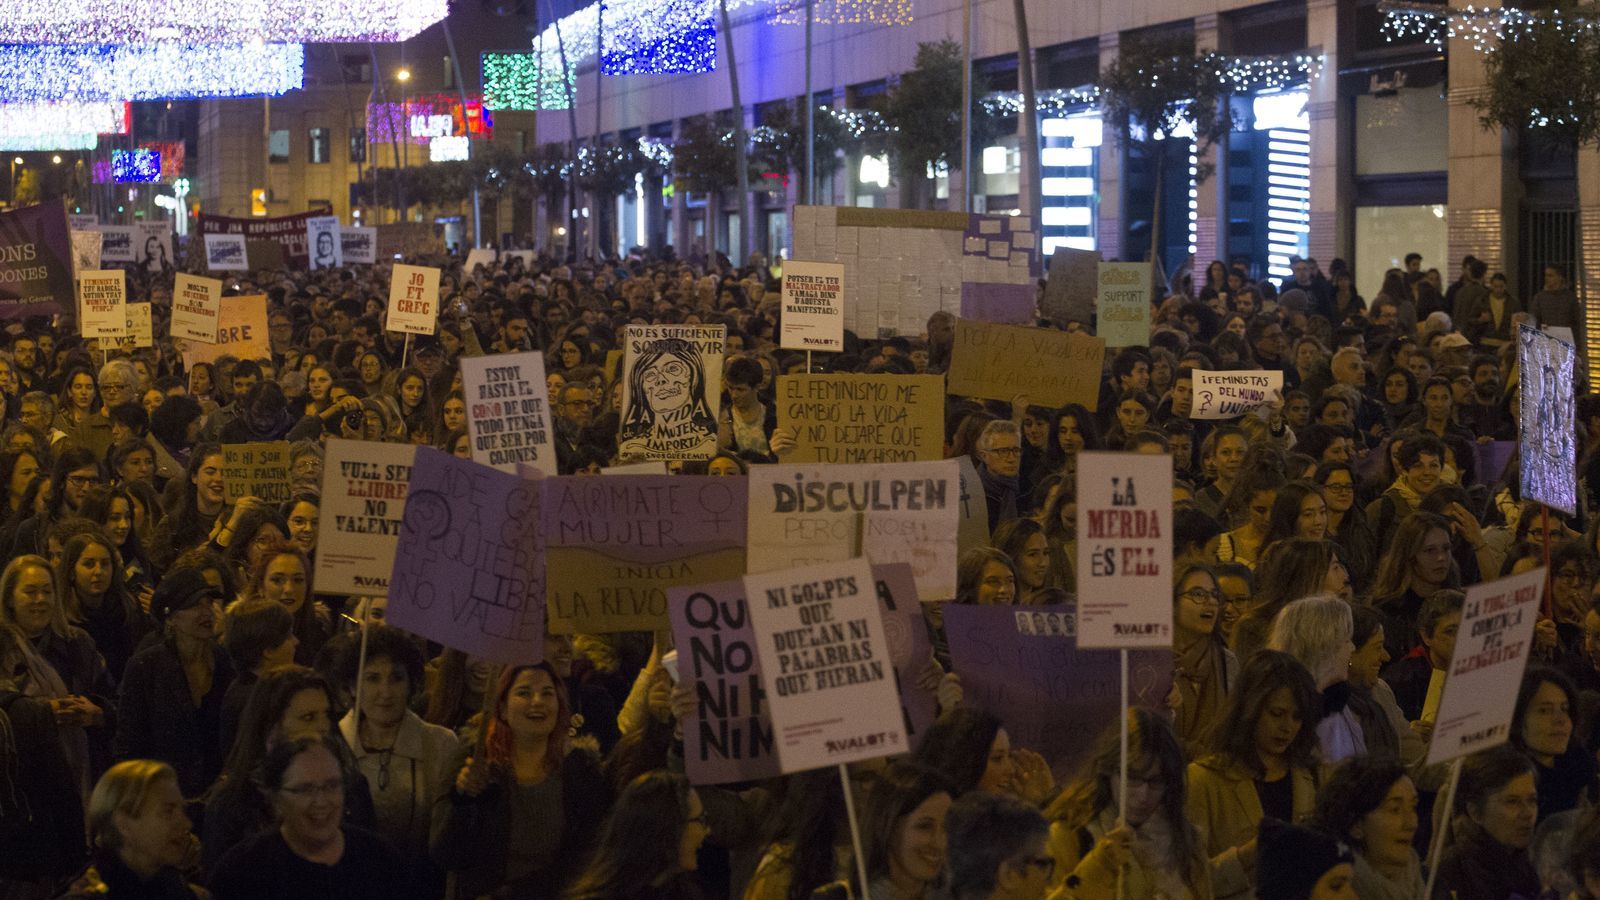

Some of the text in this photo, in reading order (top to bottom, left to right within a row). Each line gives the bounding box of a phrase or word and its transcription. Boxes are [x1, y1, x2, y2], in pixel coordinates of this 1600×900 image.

[409, 272, 425, 287] JO
[786, 283, 840, 292] MALTRACTADOR
[788, 275, 813, 283] POTSER
[406, 286, 425, 300] ET
[1104, 289, 1145, 303] SUPPORT
[397, 299, 430, 315] CREC
[628, 328, 724, 340] NO ES SUFICIENTE
[485, 365, 520, 383] ESTOY
[478, 380, 534, 400] HASTA EL
[787, 380, 921, 405] EL FEMINISMO ME
[1219, 386, 1237, 398] DEL
[1239, 388, 1265, 401] MUNDO
[472, 398, 543, 419] COÑO DE QUE
[849, 404, 867, 423] LA
[873, 405, 909, 425] VIDA
[473, 414, 545, 435] TODO TENGA
[475, 430, 547, 451] QUE SER POR
[645, 436, 701, 451] IMPORTA
[791, 427, 803, 442] Y
[808, 424, 828, 444] NO
[891, 426, 923, 448] QUE
[488, 446, 538, 466] COJONES
[813, 446, 917, 465] TU MACHISMO
[340, 461, 381, 480] VULL
[347, 480, 408, 500] LLIURE
[1111, 477, 1137, 507] LA
[363, 499, 387, 517] NO
[783, 517, 849, 540] PERO
[1086, 509, 1161, 539] MERDA
[1091, 544, 1160, 577] ÉS ELL
[765, 575, 859, 609] NI GOLPES
[554, 591, 590, 619] LA
[799, 602, 834, 626] QUE
[771, 619, 871, 651] DUELAN NI
[776, 640, 874, 674] PALABRAS
[774, 661, 885, 698] QUE HIERAN
